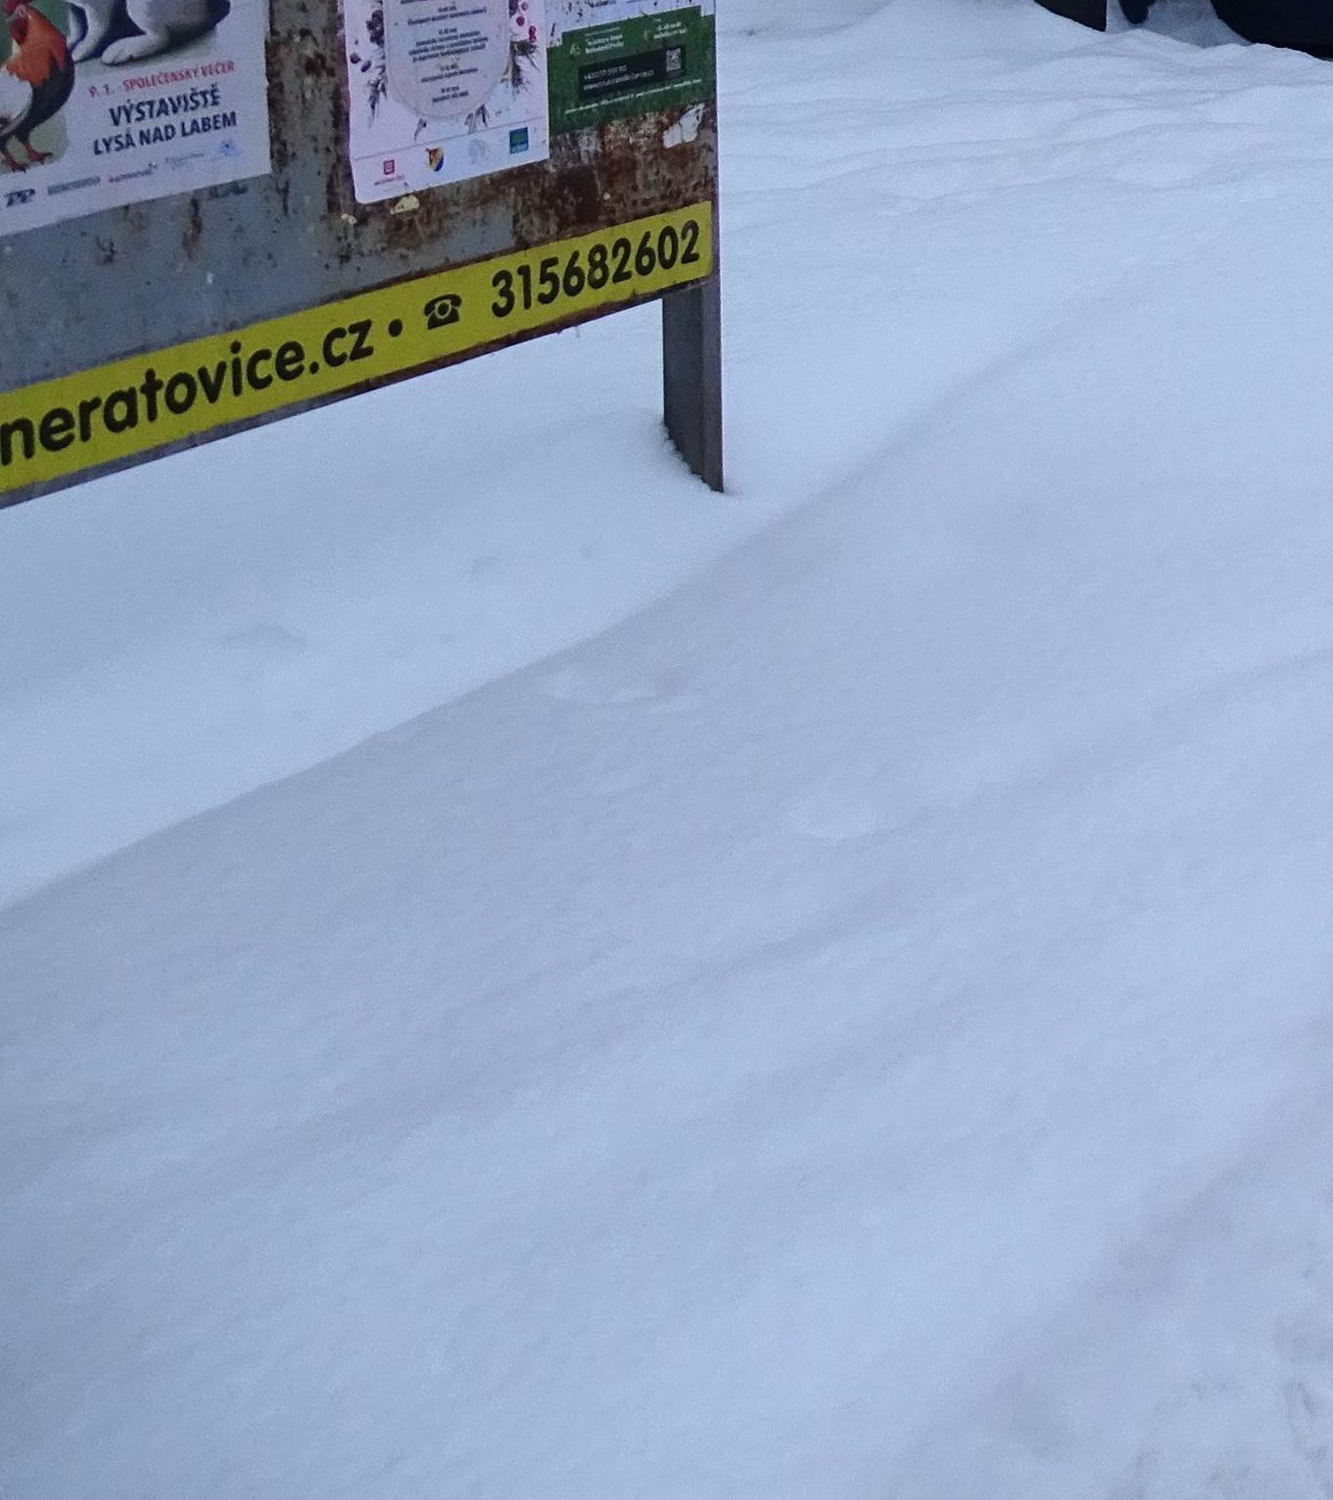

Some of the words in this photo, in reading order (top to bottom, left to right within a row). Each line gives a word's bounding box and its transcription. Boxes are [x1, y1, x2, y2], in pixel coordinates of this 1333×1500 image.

[122, 67, 199, 93] SPOLEČENSKÝ
[108, 83, 221, 127] VÝSTAVIŠTĚ
[94, 128, 136, 155] LYSÁ
[139, 125, 176, 147] NAD
[181, 111, 237, 138] LABEM
[0, 318, 374, 466] neratovice.cz
[490, 220, 700, 319] 315682602
